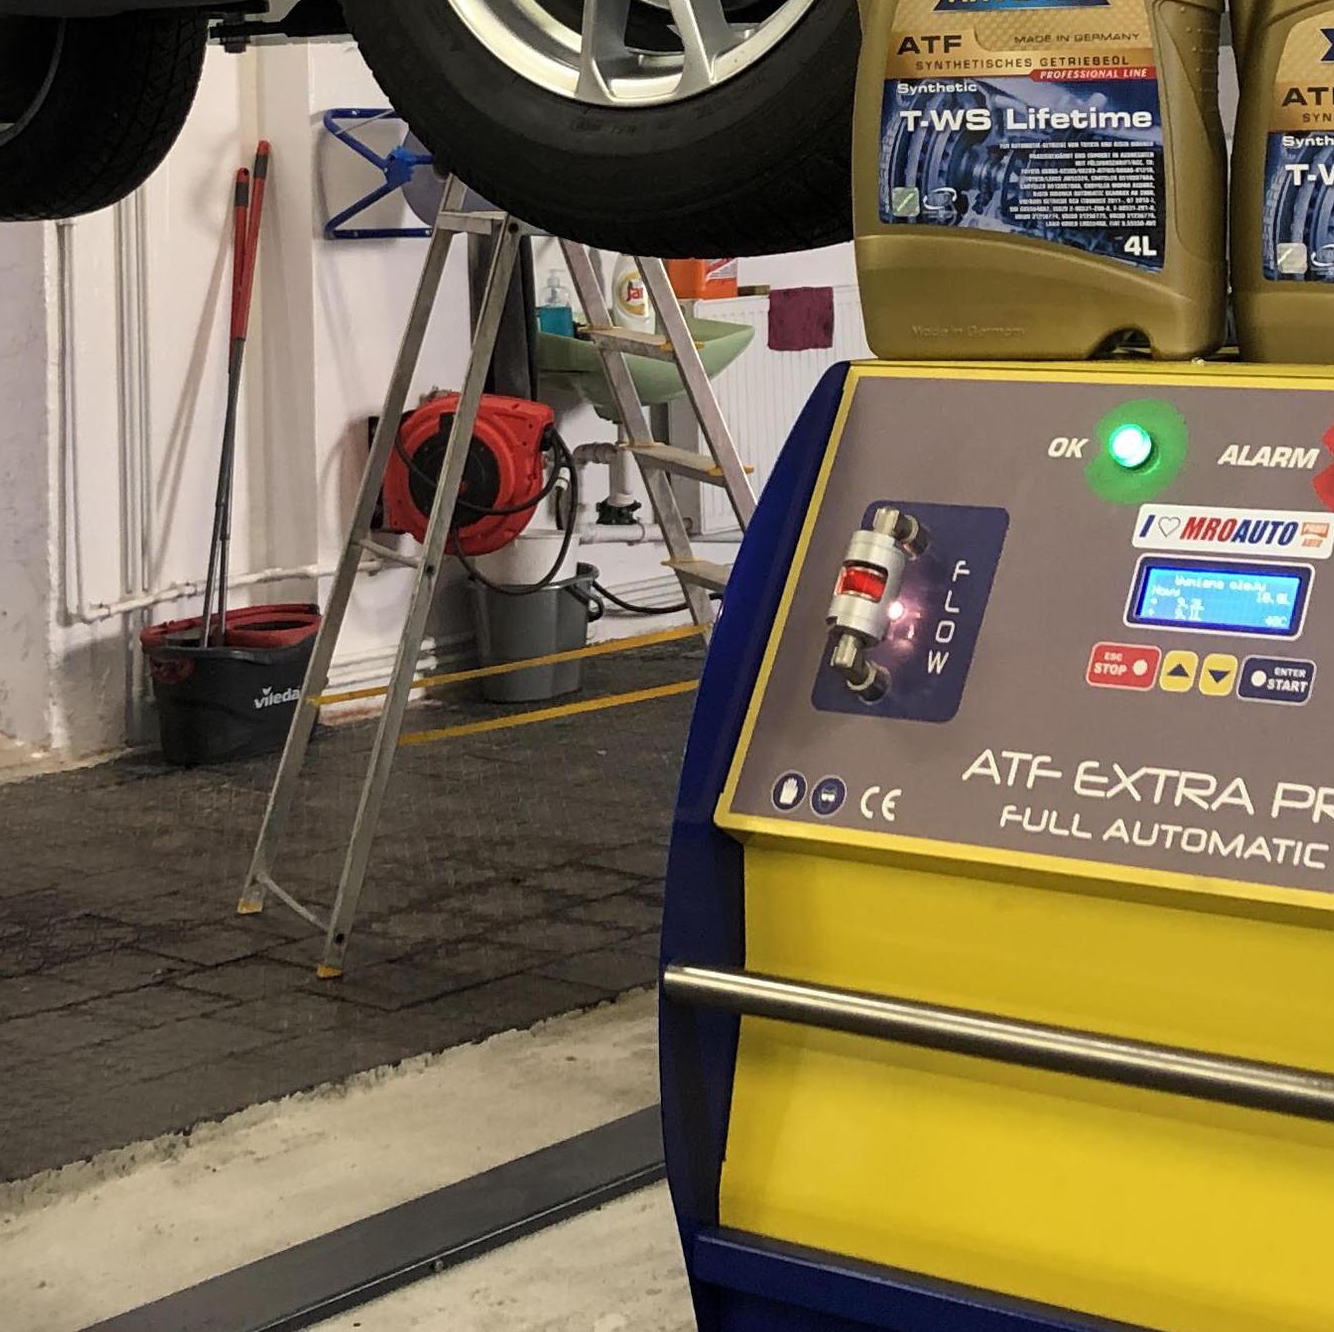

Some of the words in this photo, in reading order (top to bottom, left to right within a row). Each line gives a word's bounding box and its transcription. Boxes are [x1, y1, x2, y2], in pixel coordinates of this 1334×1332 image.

[897, 34, 963, 57] ATF
[1014, 34, 1052, 45] MADE
[1056, 33, 1070, 43] IN
[1074, 32, 1141, 43] GERMANY
[915, 57, 1033, 71] SYNTHETISCHES
[1039, 69, 1120, 80] PROFESSIONAL
[1123, 68, 1148, 78] LINE
[896, 82, 978, 96] Synthetic
[899, 108, 992, 133] T-WS
[1005, 106, 1153, 131] Lifetime
[1123, 235, 1158, 257] 4L
[1047, 437, 1090, 459] OK
[1217, 444, 1321, 469] ALARM
[1138, 514, 1156, 538] I
[1179, 516, 1300, 547] MROAUTO
[927, 560, 970, 675] FLOW
[1104, 651, 1122, 661] ESC
[1093, 662, 1127, 676] STOP
[1274, 666, 1306, 679] ENTER
[1266, 677, 1309, 693] START
[253, 685, 301, 709] vileda
[961, 748, 1063, 790] ATF
[1073, 760, 1255, 816] EXTRA
[860, 786, 902, 822] CE
[999, 804, 1092, 839] FULL
[1101, 817, 1330, 869] AUTOMATIC
